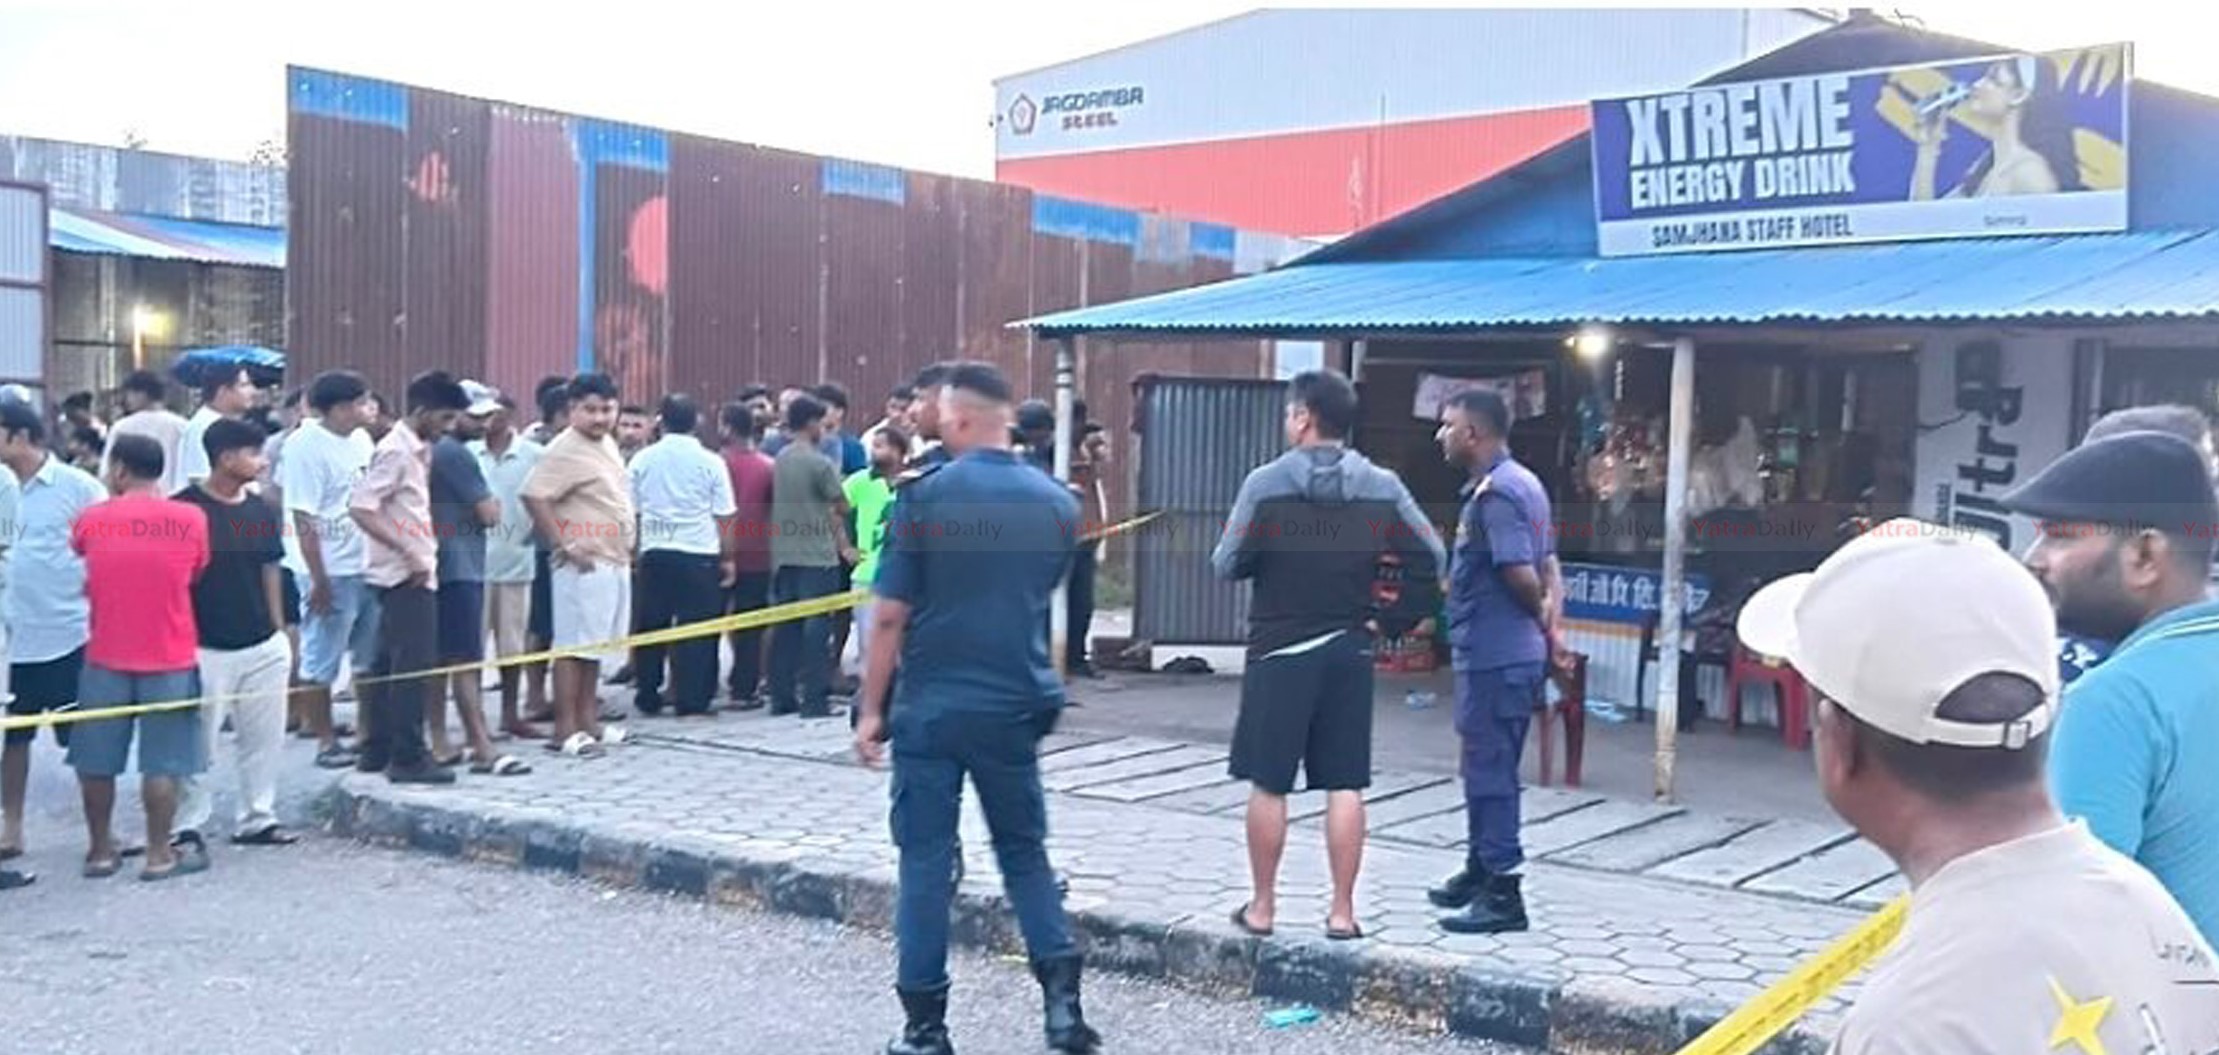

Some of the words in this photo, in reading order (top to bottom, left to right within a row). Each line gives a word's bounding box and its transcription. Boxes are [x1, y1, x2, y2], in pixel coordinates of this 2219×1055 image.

[1041, 87, 1143, 114] JAGDAMBA
[1626, 77, 1854, 167] XTREME
[1631, 160, 1744, 209] ENERGY
[1754, 152, 1855, 198] DRINK
[1652, 220, 1742, 247] SAMJHANA
[1747, 216, 1796, 241] STAFF
[1800, 213, 1853, 237] HOTEL
